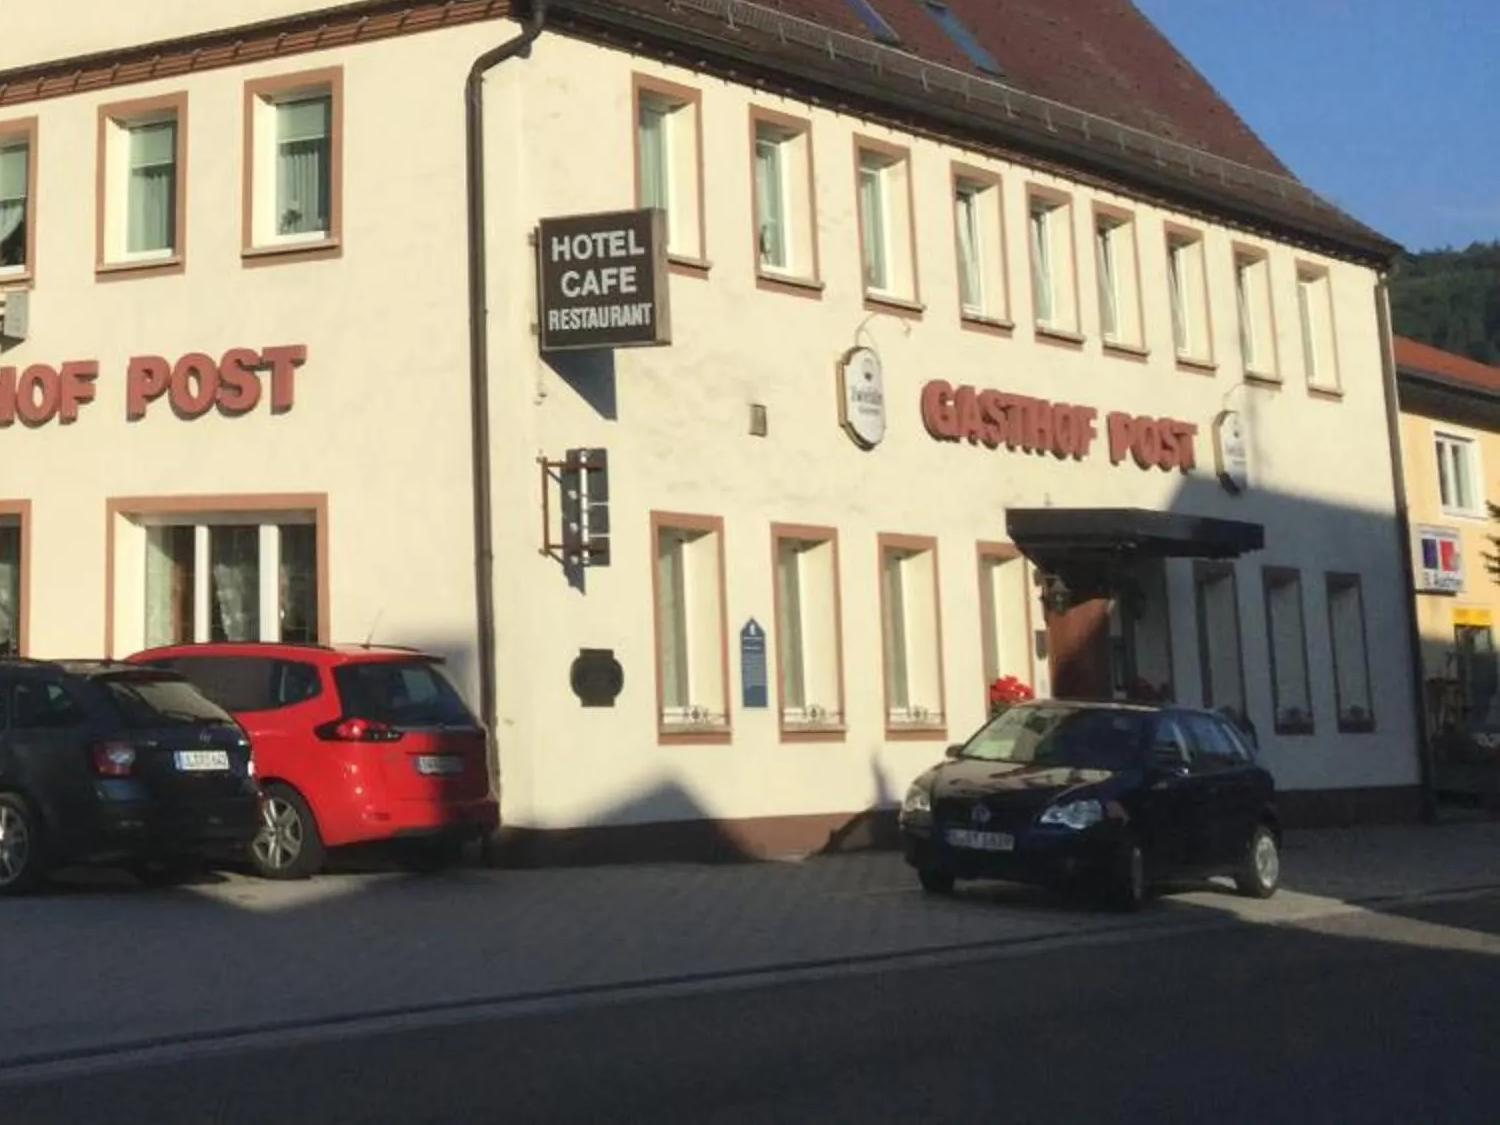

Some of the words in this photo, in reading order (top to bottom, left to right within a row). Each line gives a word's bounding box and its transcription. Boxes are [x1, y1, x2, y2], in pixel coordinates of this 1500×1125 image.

[551, 229, 645, 262] HOTEL
[561, 266, 637, 298] CAFE
[547, 302, 653, 332] RESTAURANT
[126, 344, 308, 422] POST
[920, 379, 1098, 461] GASTHOF
[1106, 411, 1198, 474] POST
